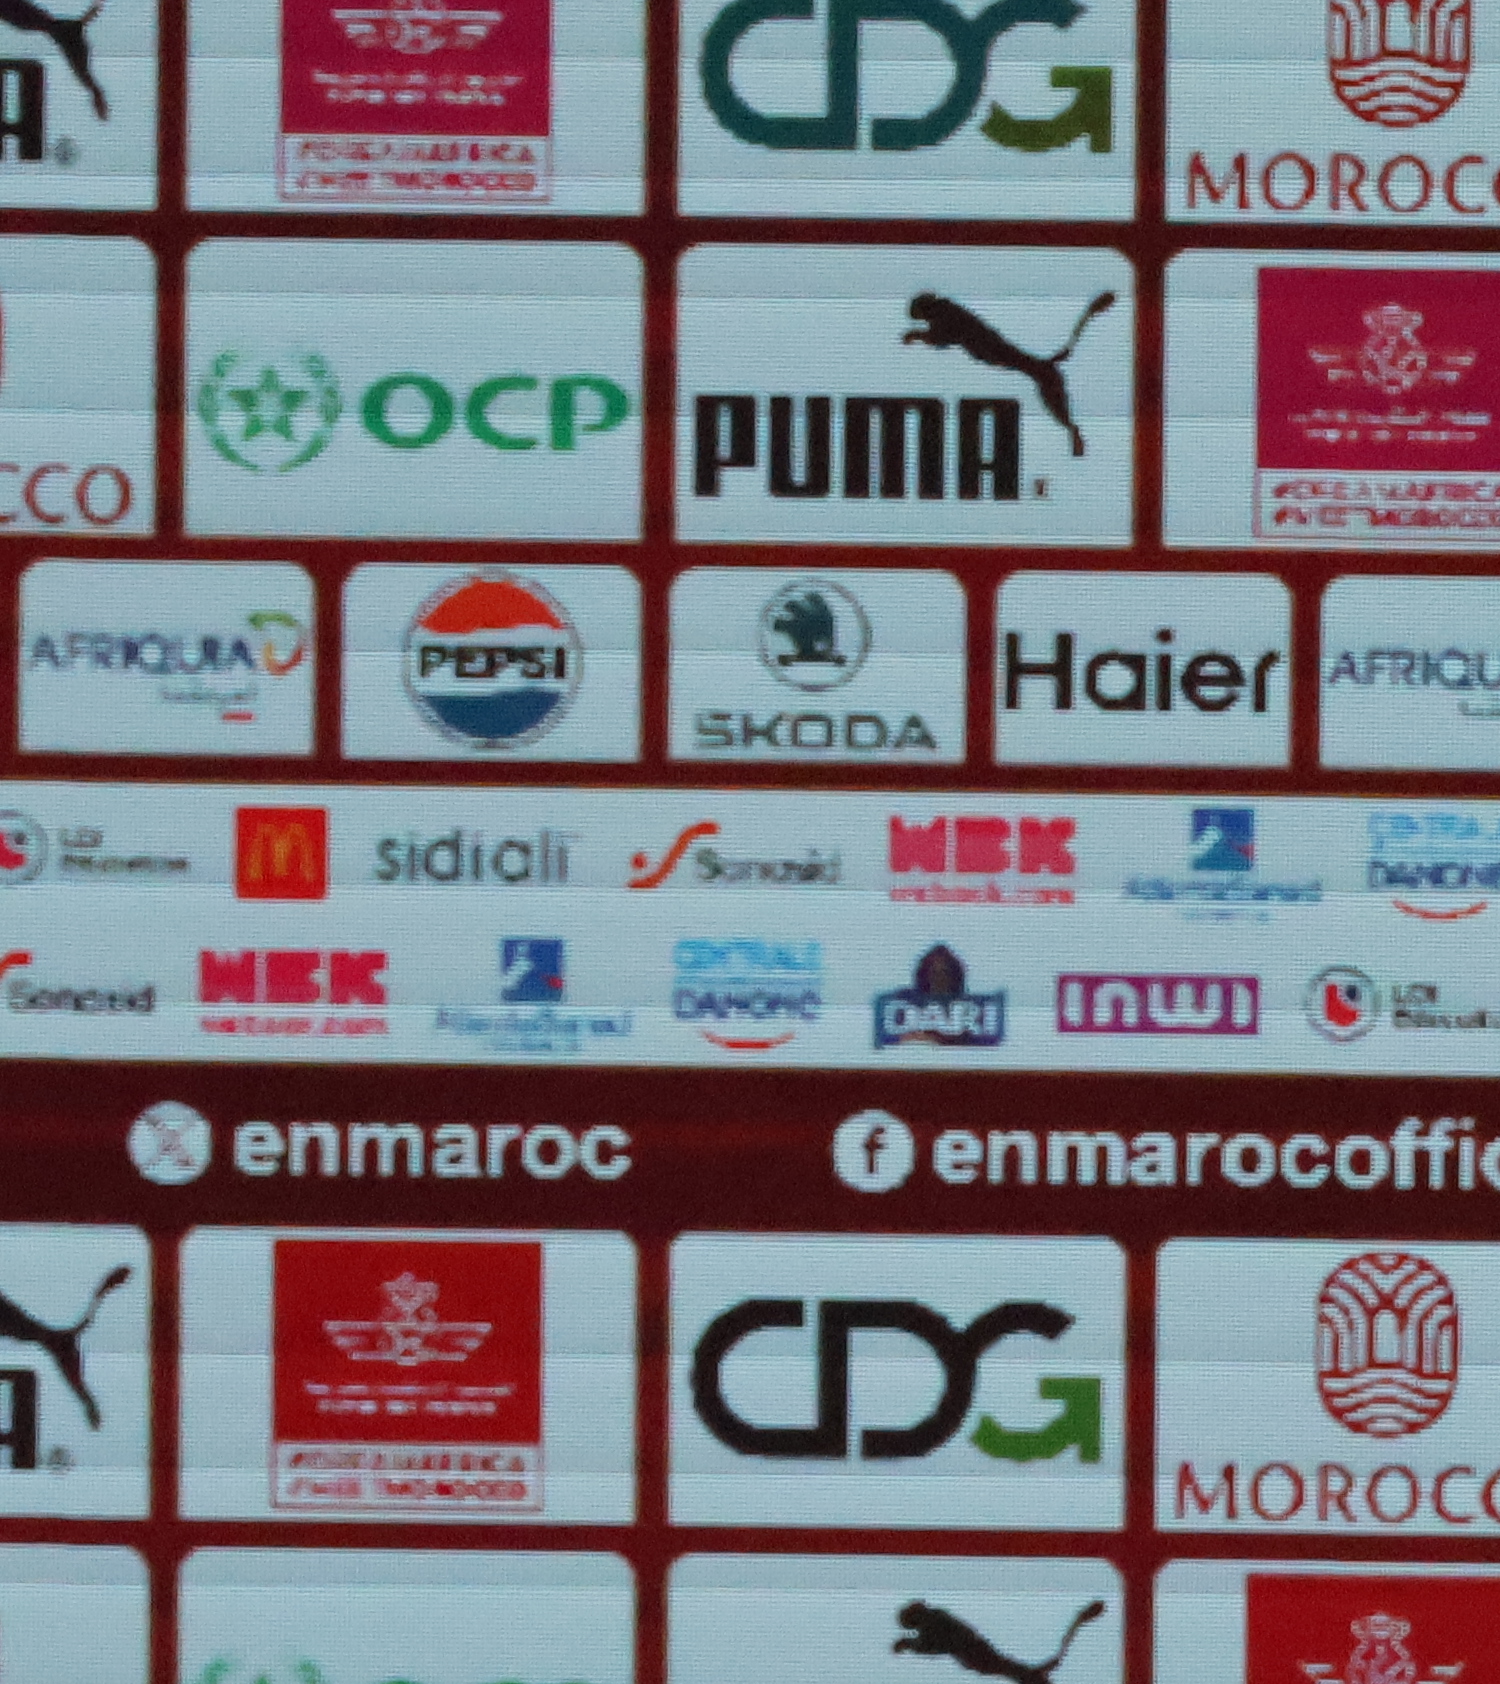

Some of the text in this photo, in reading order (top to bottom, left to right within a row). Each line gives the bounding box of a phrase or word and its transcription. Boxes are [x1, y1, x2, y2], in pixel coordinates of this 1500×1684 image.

[700, 0, 1112, 153] CDG
[360, 373, 632, 452] OCP
[694, 394, 1021, 500] PUMA
[34, 633, 254, 674] AFRIQUIA
[420, 645, 566, 679] PEPSI
[1004, 629, 1279, 712] Haier
[886, 1002, 997, 1039] DARI
[1062, 983, 1255, 1030] inwi
[234, 1121, 631, 1180] enmaroc
[690, 1299, 1101, 1462] CDG
